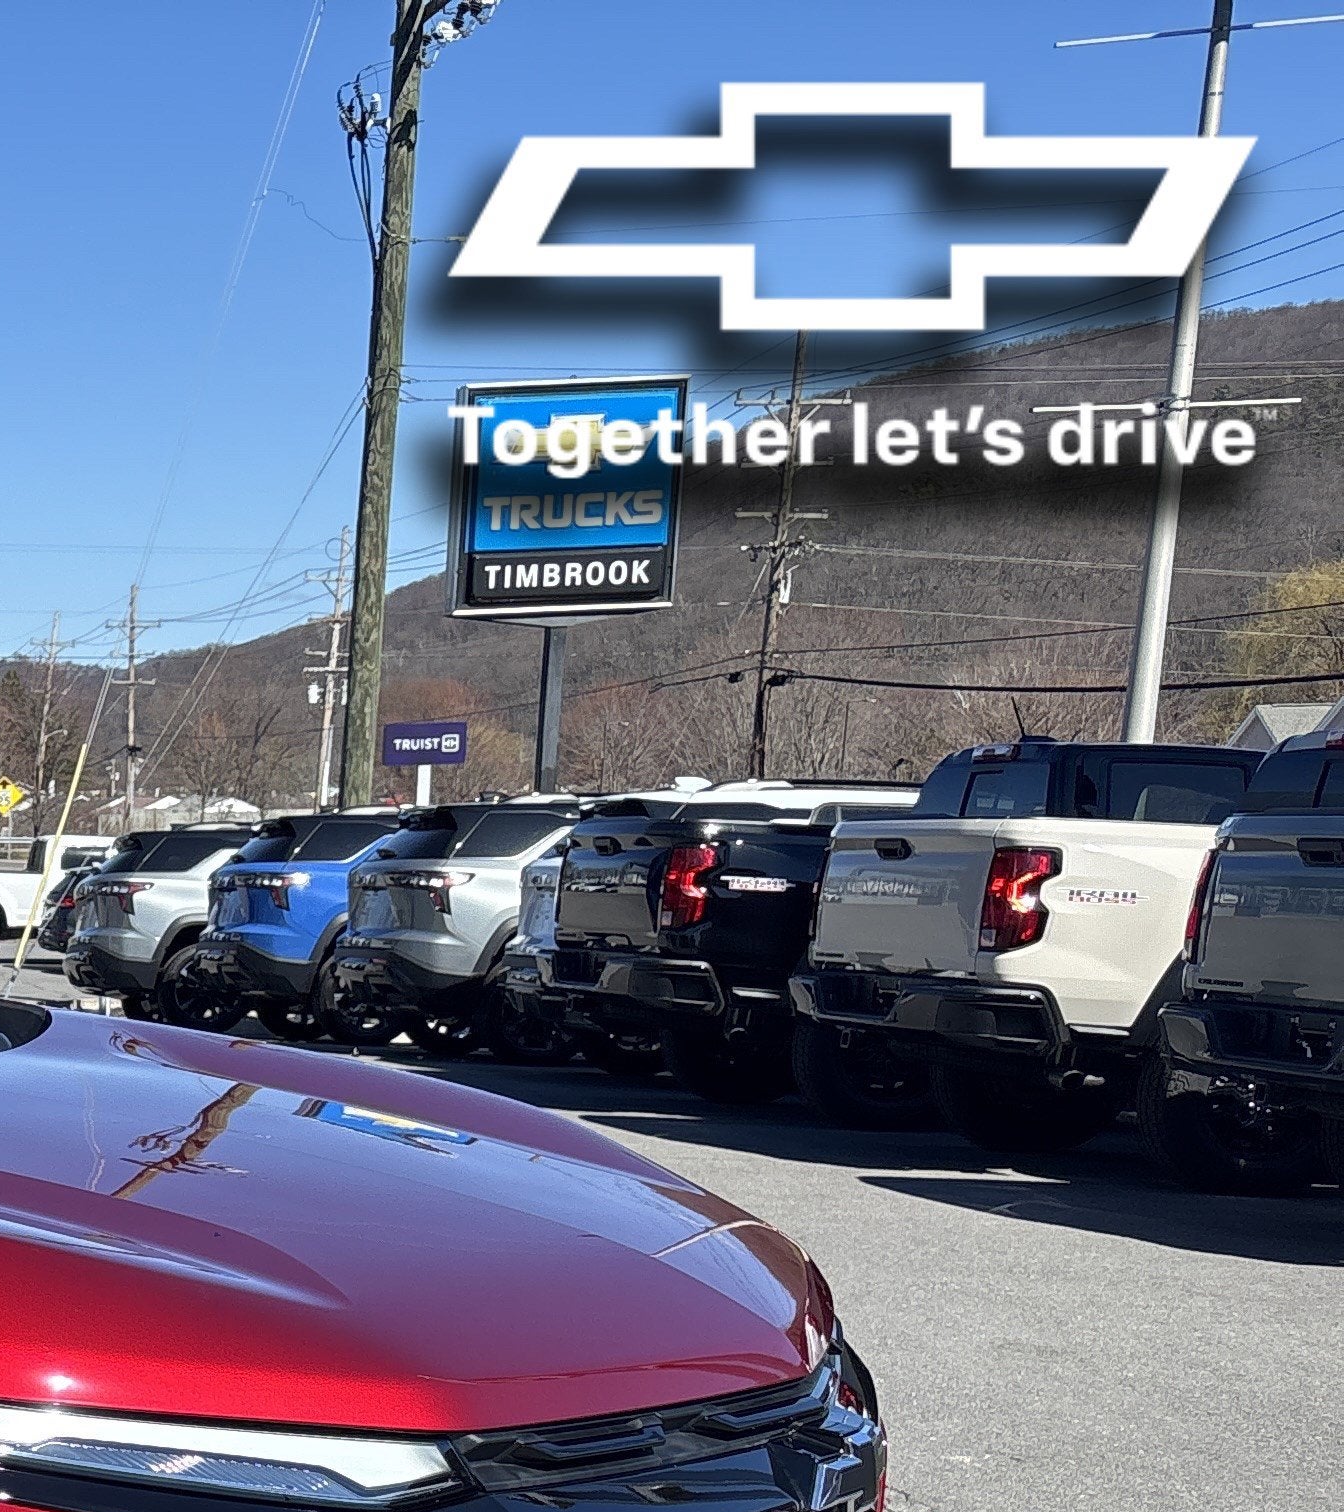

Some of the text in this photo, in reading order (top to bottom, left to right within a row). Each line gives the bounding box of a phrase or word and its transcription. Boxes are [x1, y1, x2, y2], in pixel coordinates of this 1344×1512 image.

[483, 490, 663, 532] TRUCKS
[484, 559, 651, 590] TIMBROOK
[393, 737, 441, 751] TRUIST
